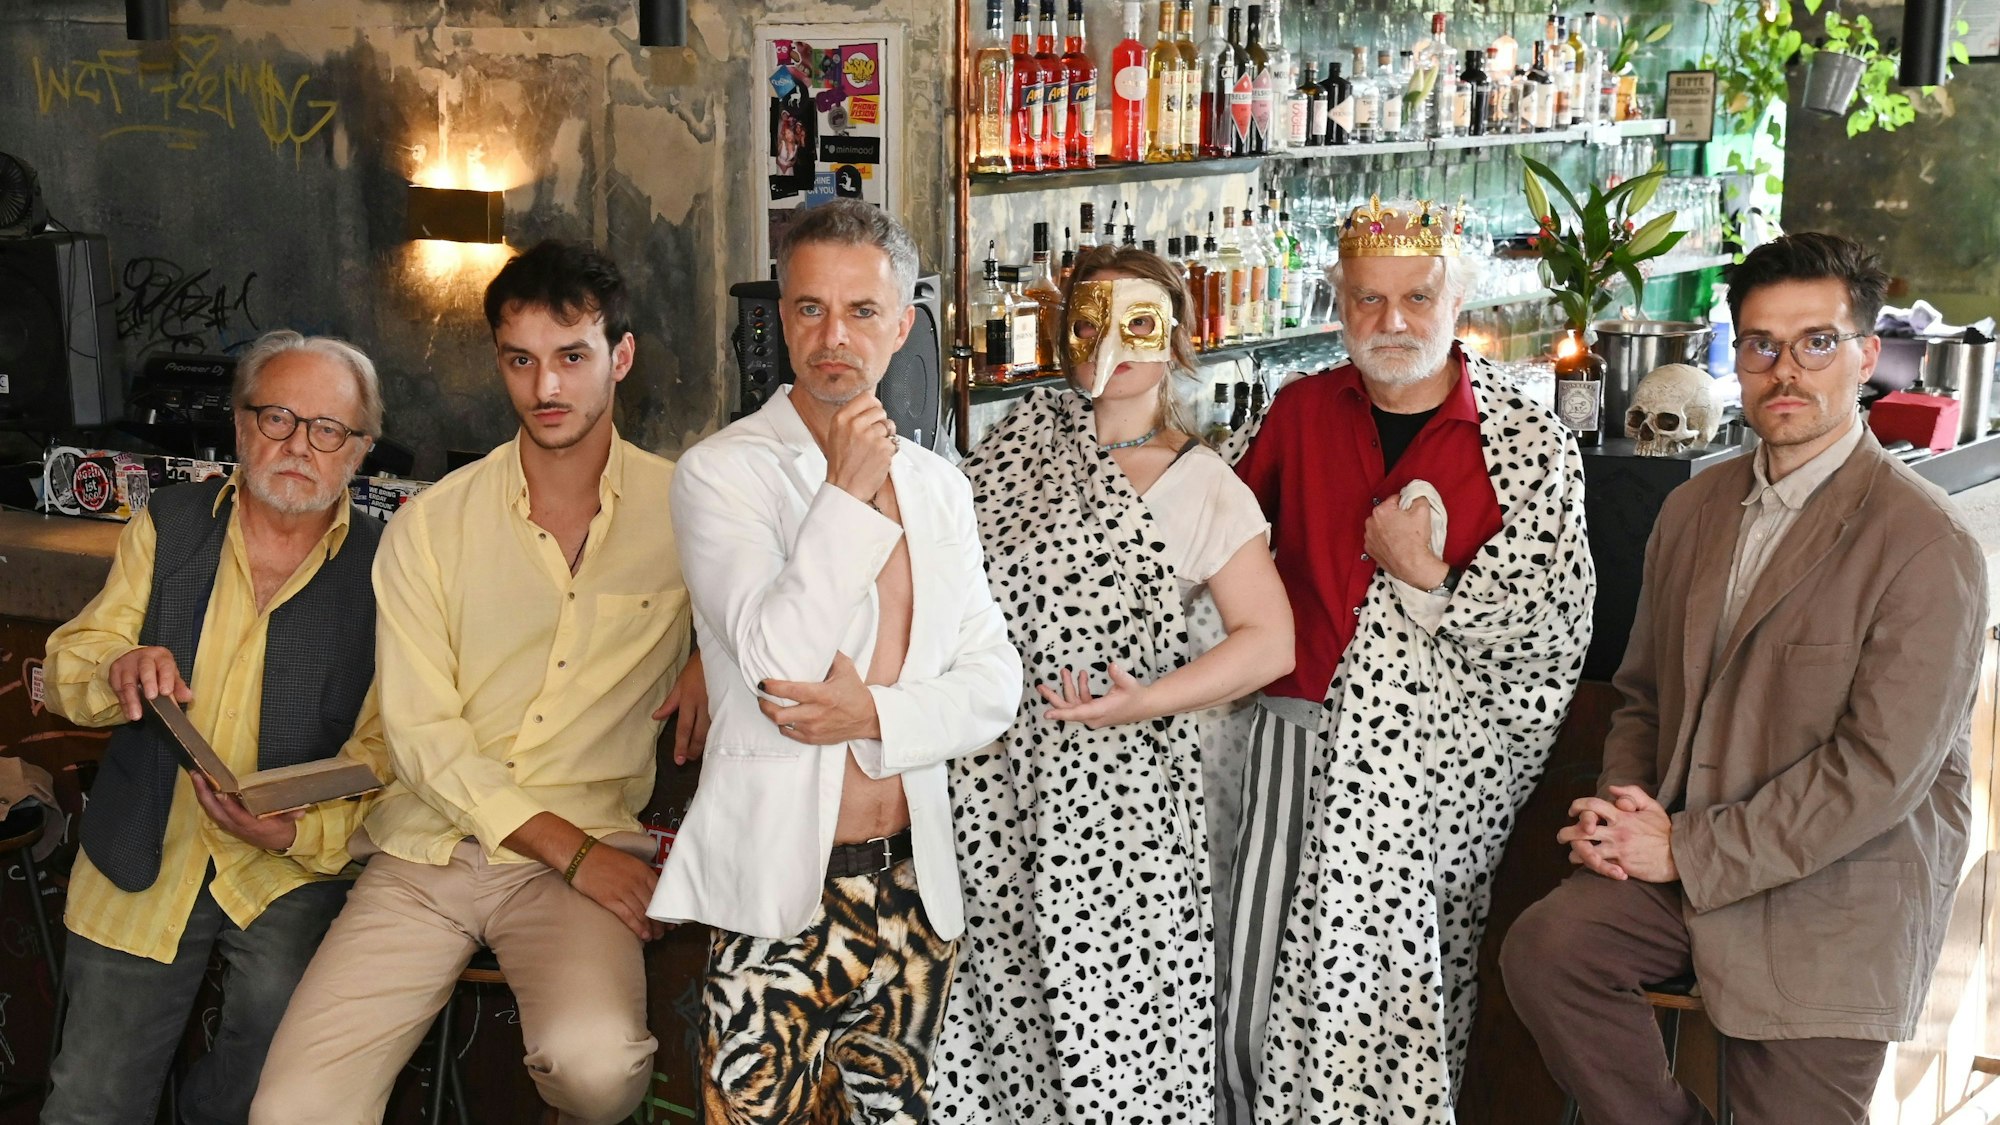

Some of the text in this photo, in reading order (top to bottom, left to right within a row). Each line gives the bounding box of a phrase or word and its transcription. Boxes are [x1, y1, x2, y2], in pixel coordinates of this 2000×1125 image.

[836, 145, 874, 155] minimood
[813, 176, 831, 185] HINE
[819, 186, 834, 195] YOU
[164, 362, 211, 374] Pioneer
[85, 480, 97, 492] ist
[369, 493, 388, 502] ERDAY
[379, 487, 397, 498] BRING
